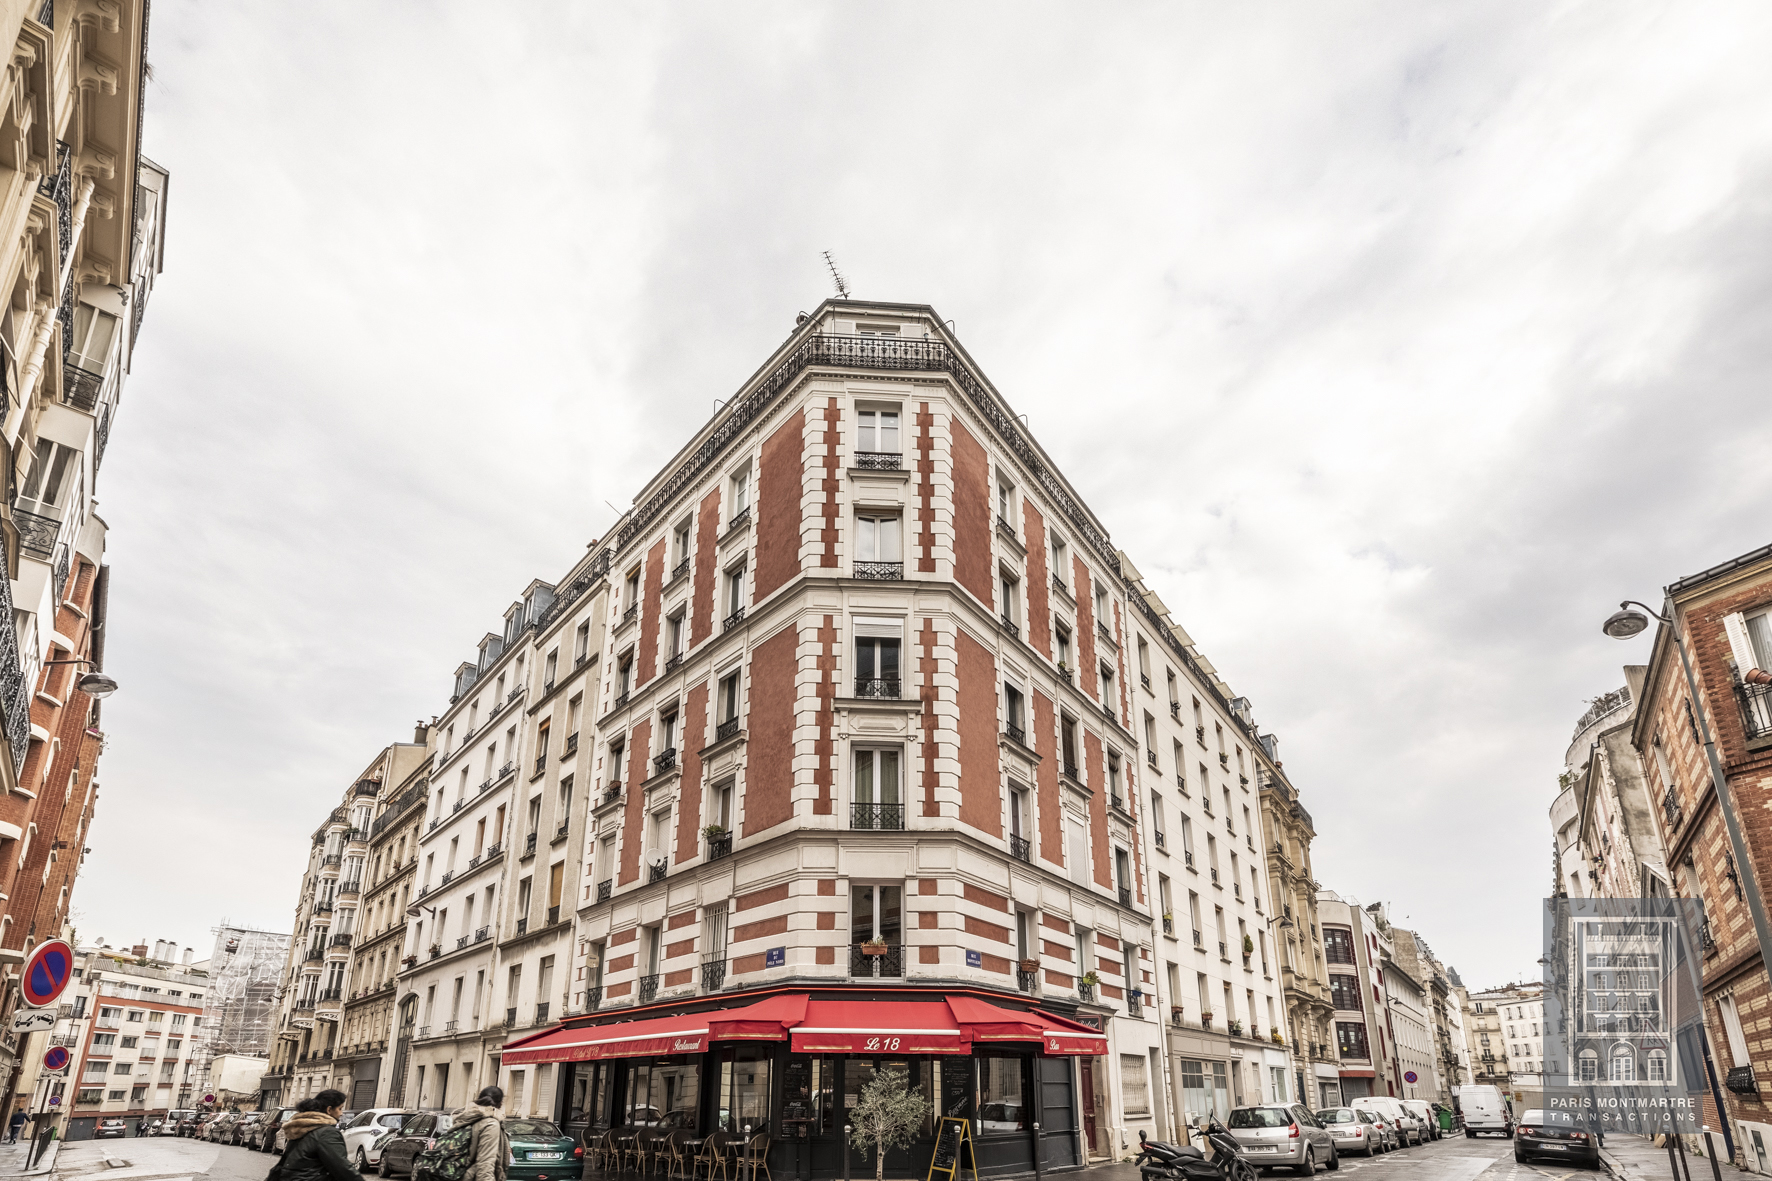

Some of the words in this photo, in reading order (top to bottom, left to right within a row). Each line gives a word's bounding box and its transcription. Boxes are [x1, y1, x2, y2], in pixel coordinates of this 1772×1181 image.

[673, 1038, 701, 1051] Restaurant
[863, 1037, 880, 1051] Le
[883, 1037, 901, 1051] 18
[1049, 1038, 1060, 1051] Bar
